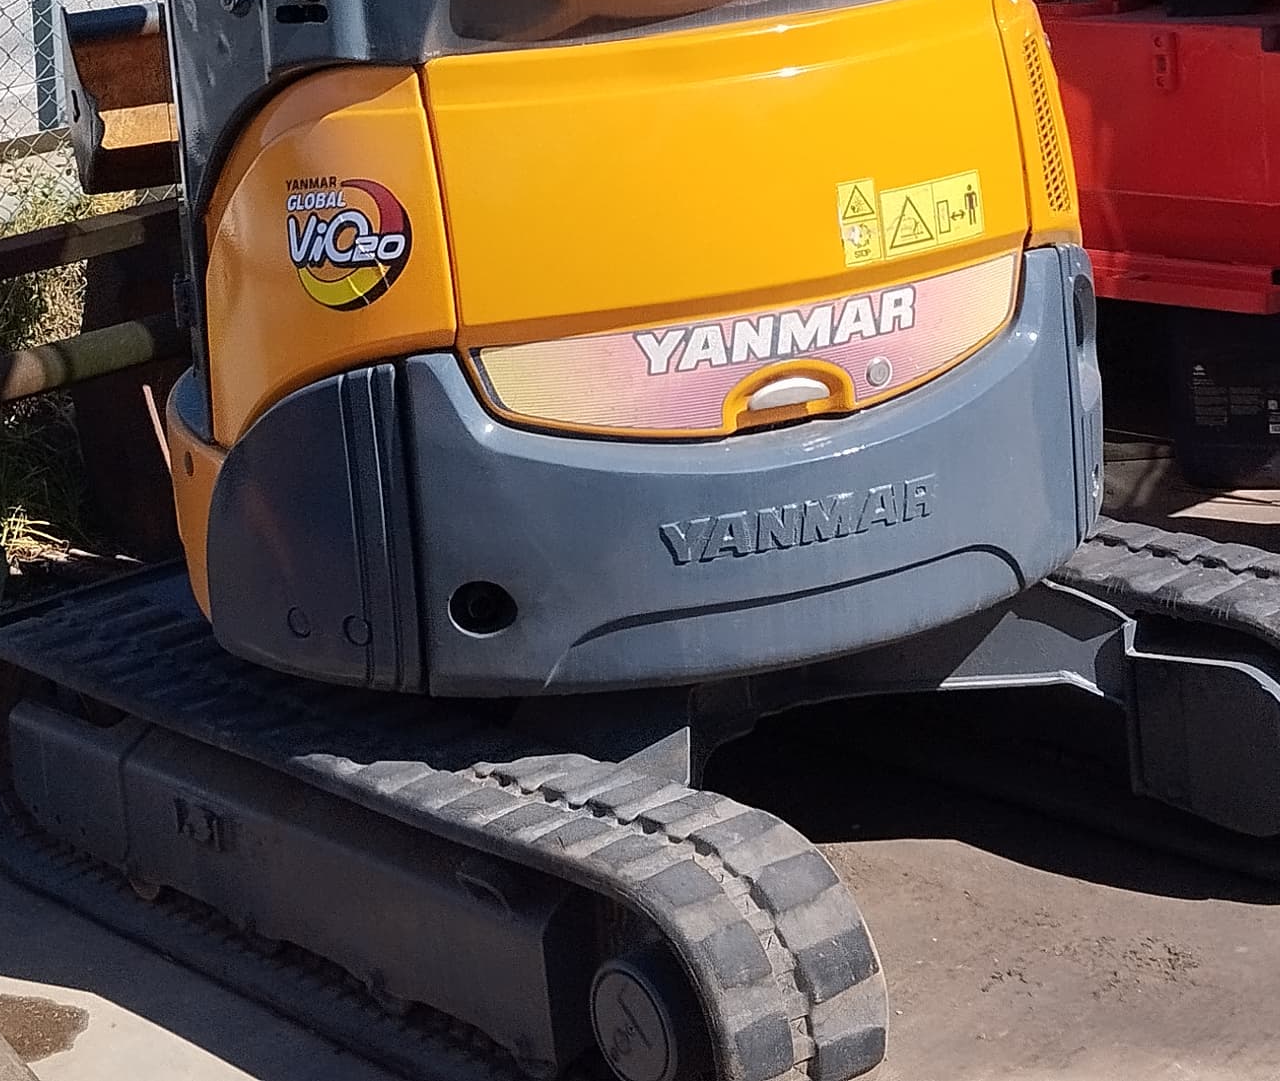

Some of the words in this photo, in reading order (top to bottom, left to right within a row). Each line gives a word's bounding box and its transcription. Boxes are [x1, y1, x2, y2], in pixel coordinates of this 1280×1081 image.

[285, 175, 338, 191] YANMAR
[286, 190, 347, 212] GLOBAL
[854, 248, 871, 259] STOP
[634, 285, 917, 376] YANMAR
[658, 473, 937, 566] YANMAR
